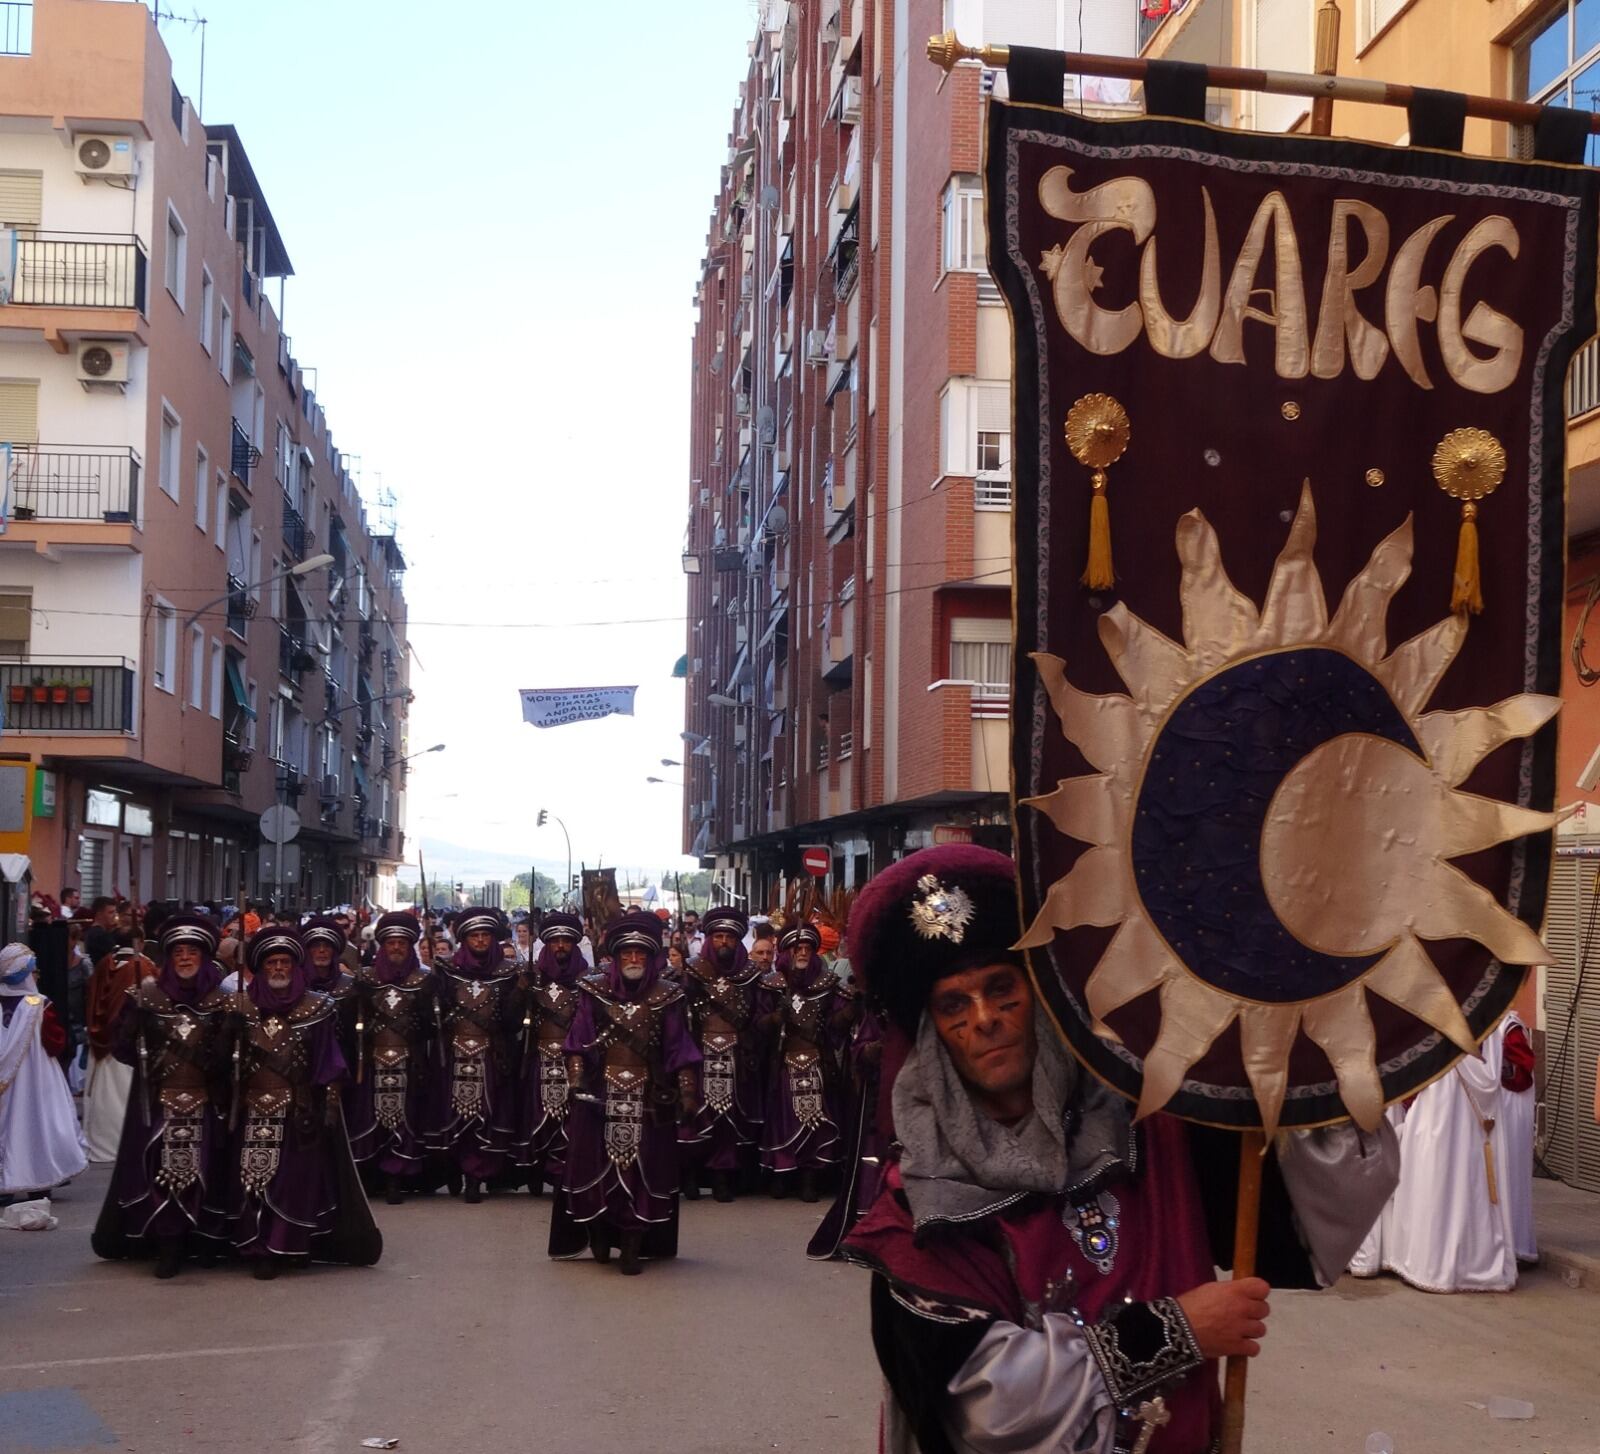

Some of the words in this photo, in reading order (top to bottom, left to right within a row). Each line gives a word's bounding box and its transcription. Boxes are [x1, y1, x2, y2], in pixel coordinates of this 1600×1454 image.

[1038, 165, 1524, 394] TUAREG
[526, 695, 568, 703] MOROS
[555, 698, 601, 708] PIRATAS
[545, 703, 611, 717] ANDALUCES
